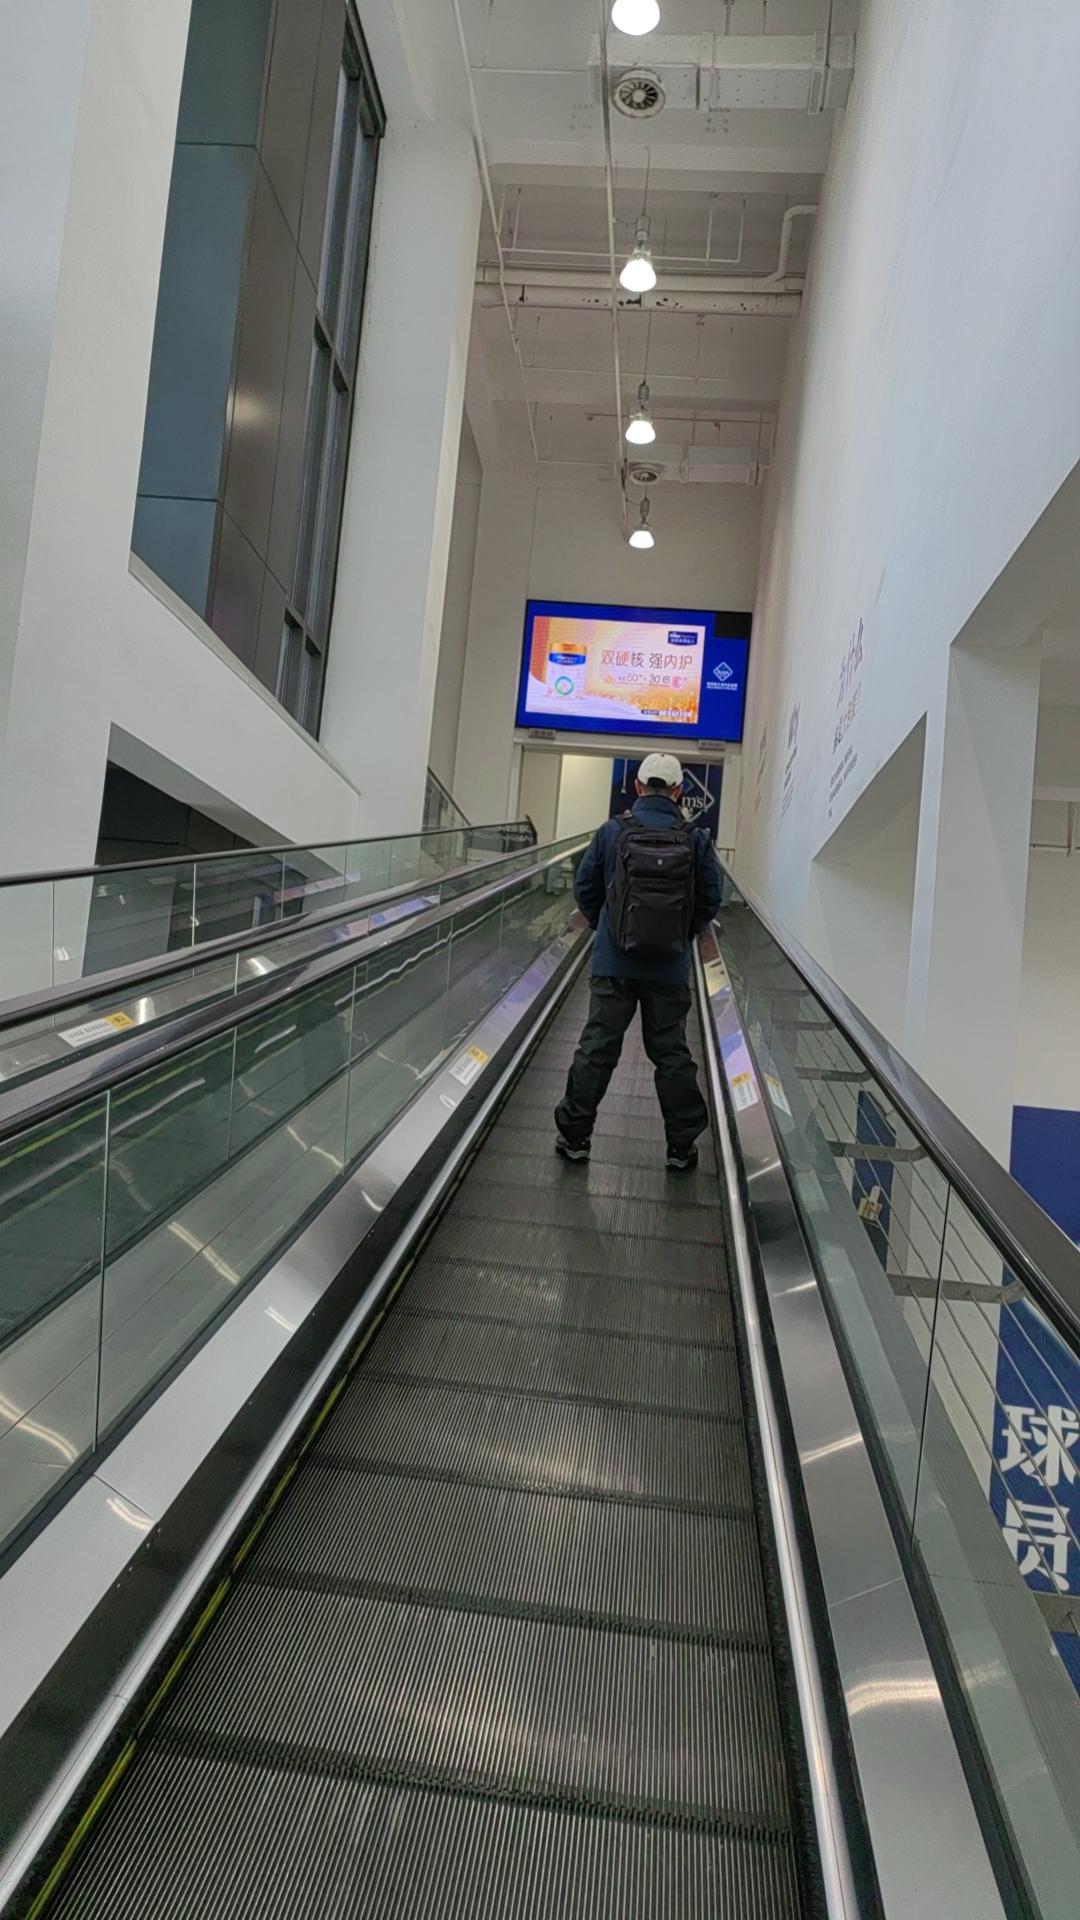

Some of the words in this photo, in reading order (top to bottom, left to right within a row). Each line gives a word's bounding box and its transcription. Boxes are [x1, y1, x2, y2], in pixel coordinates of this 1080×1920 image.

[600, 650, 645, 669] 双硬核
[649, 653, 693, 670] 强内护
[681, 795, 704, 808] m's
[999, 1404, 1080, 1591] 球员
